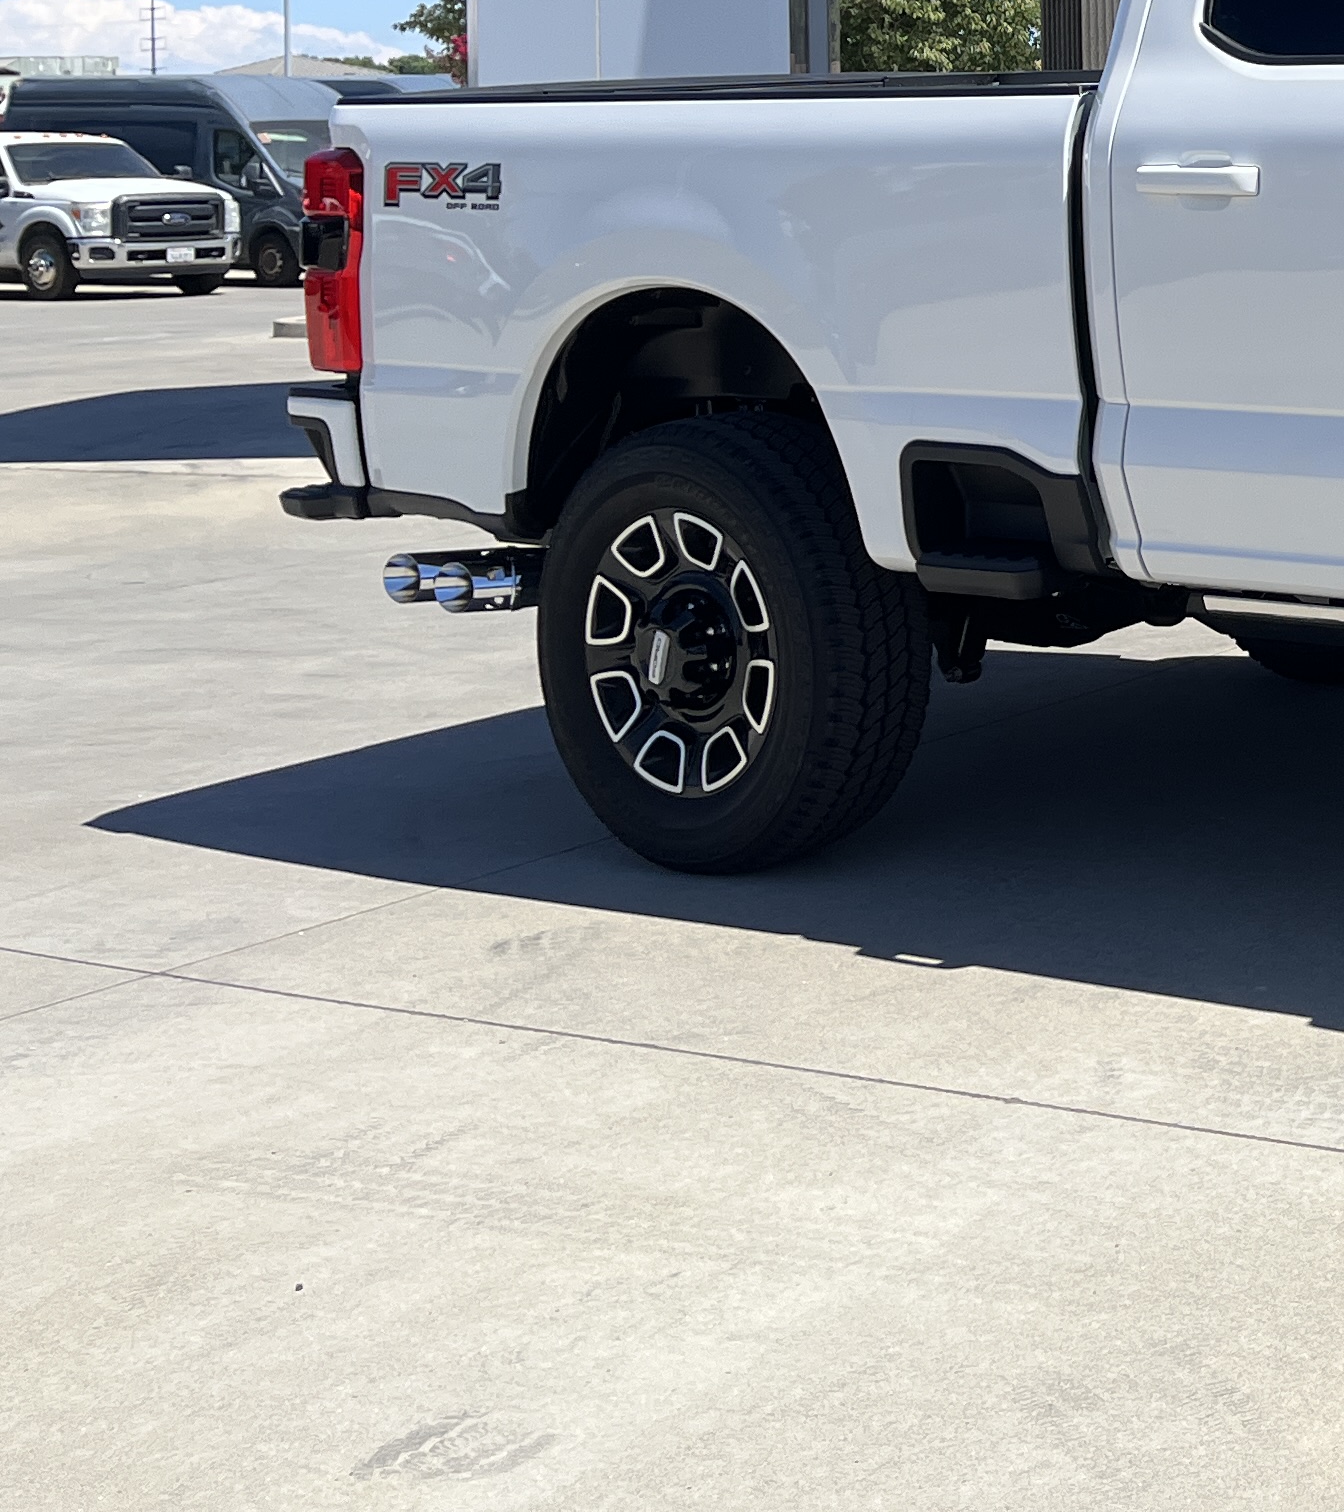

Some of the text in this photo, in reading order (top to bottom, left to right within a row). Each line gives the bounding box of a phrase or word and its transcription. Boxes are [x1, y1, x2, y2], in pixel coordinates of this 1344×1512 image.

[384, 162, 502, 208] FX4
[446, 202, 500, 211] OFF ROAD
